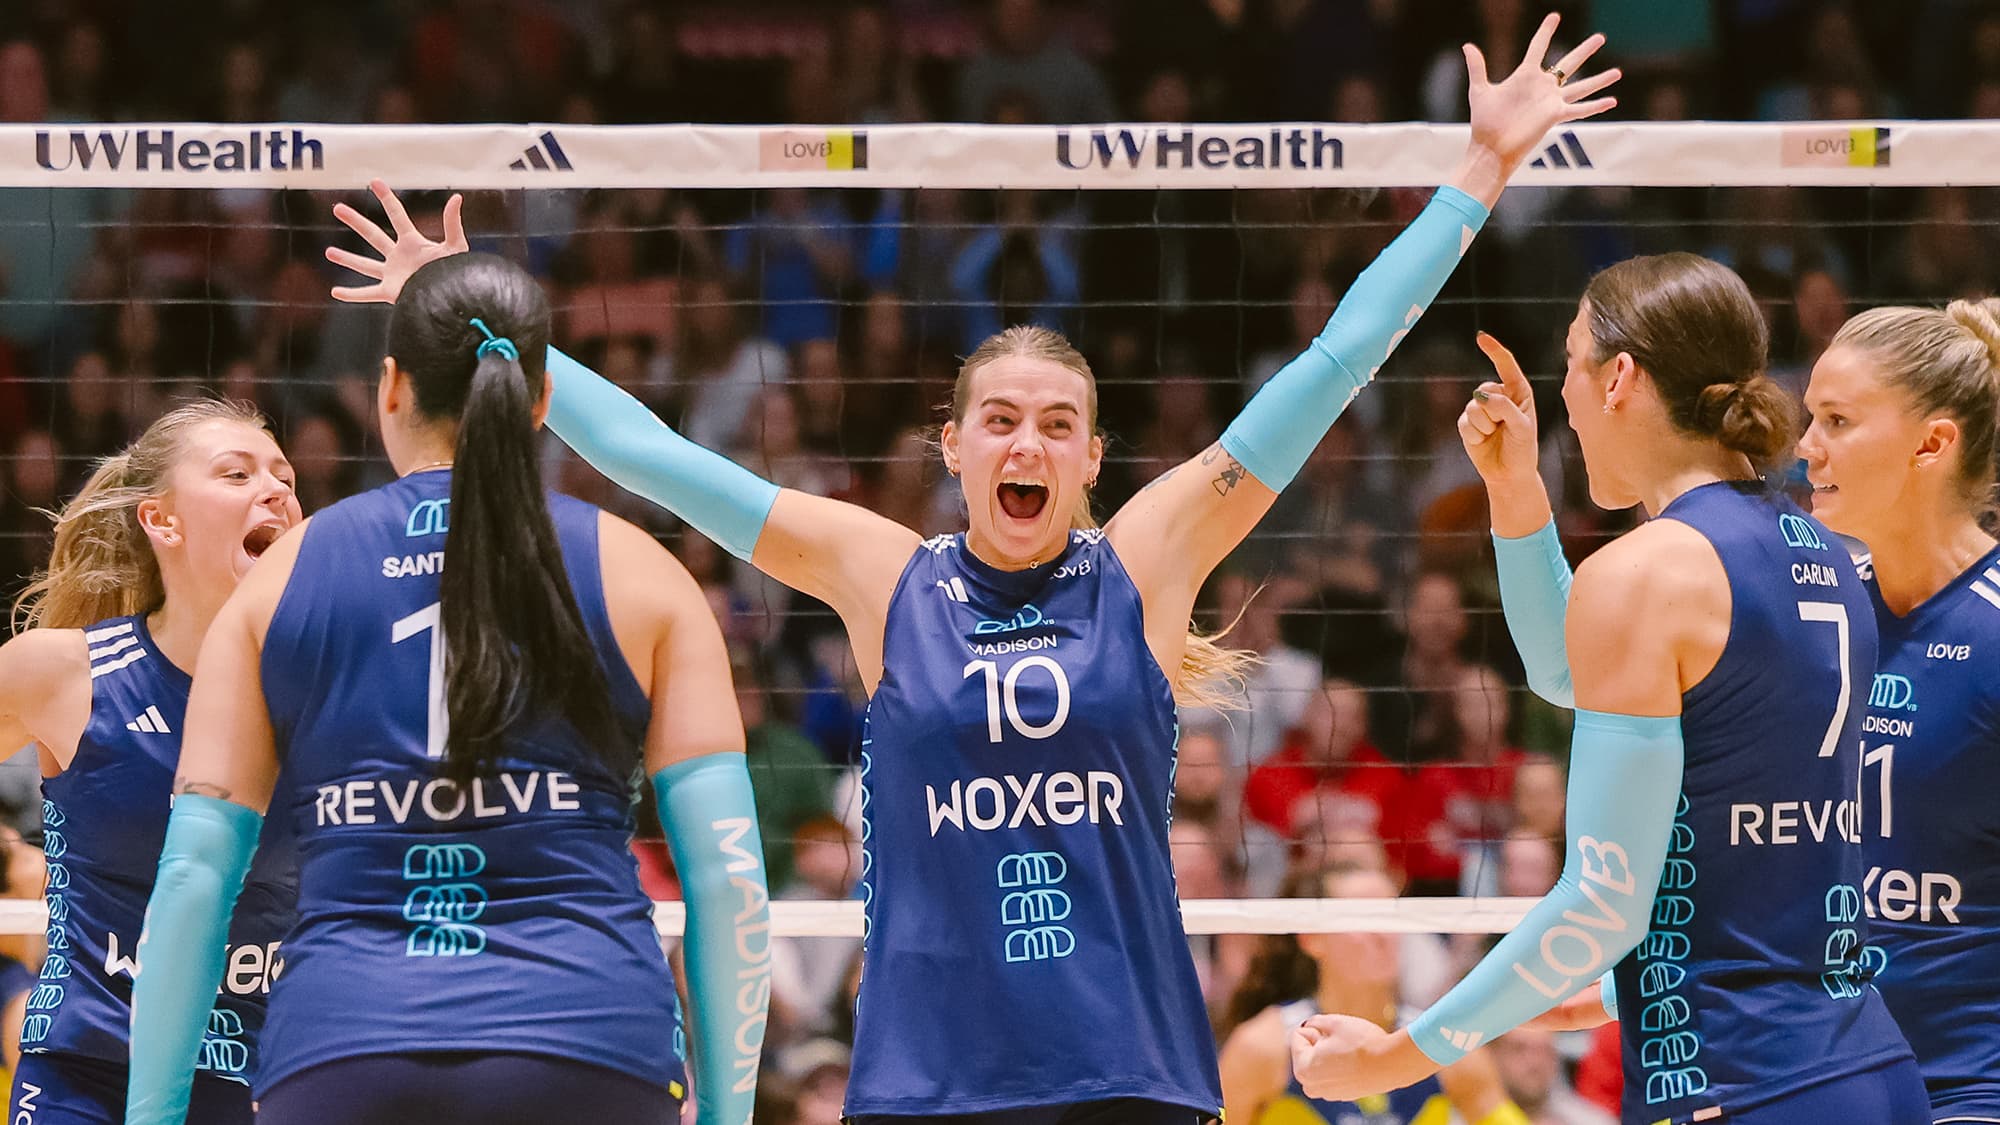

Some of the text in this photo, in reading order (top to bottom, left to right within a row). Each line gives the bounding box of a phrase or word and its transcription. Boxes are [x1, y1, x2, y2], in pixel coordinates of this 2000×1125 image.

[382, 552, 445, 578] SANT
[1050, 559, 1092, 579] OVB
[1791, 563, 1839, 587] CARLINI
[967, 634, 1058, 656] MADISON
[1926, 643, 1971, 661] LOVB
[391, 602, 449, 757] 1
[963, 655, 1071, 743] 10
[1797, 601, 1851, 757] 7
[1862, 716, 1913, 738] DISON
[315, 771, 580, 826] REVOLVE
[1729, 800, 1862, 846] REVOL
[1512, 835, 1635, 999] LOVB
[711, 817, 772, 1094] MADISON
